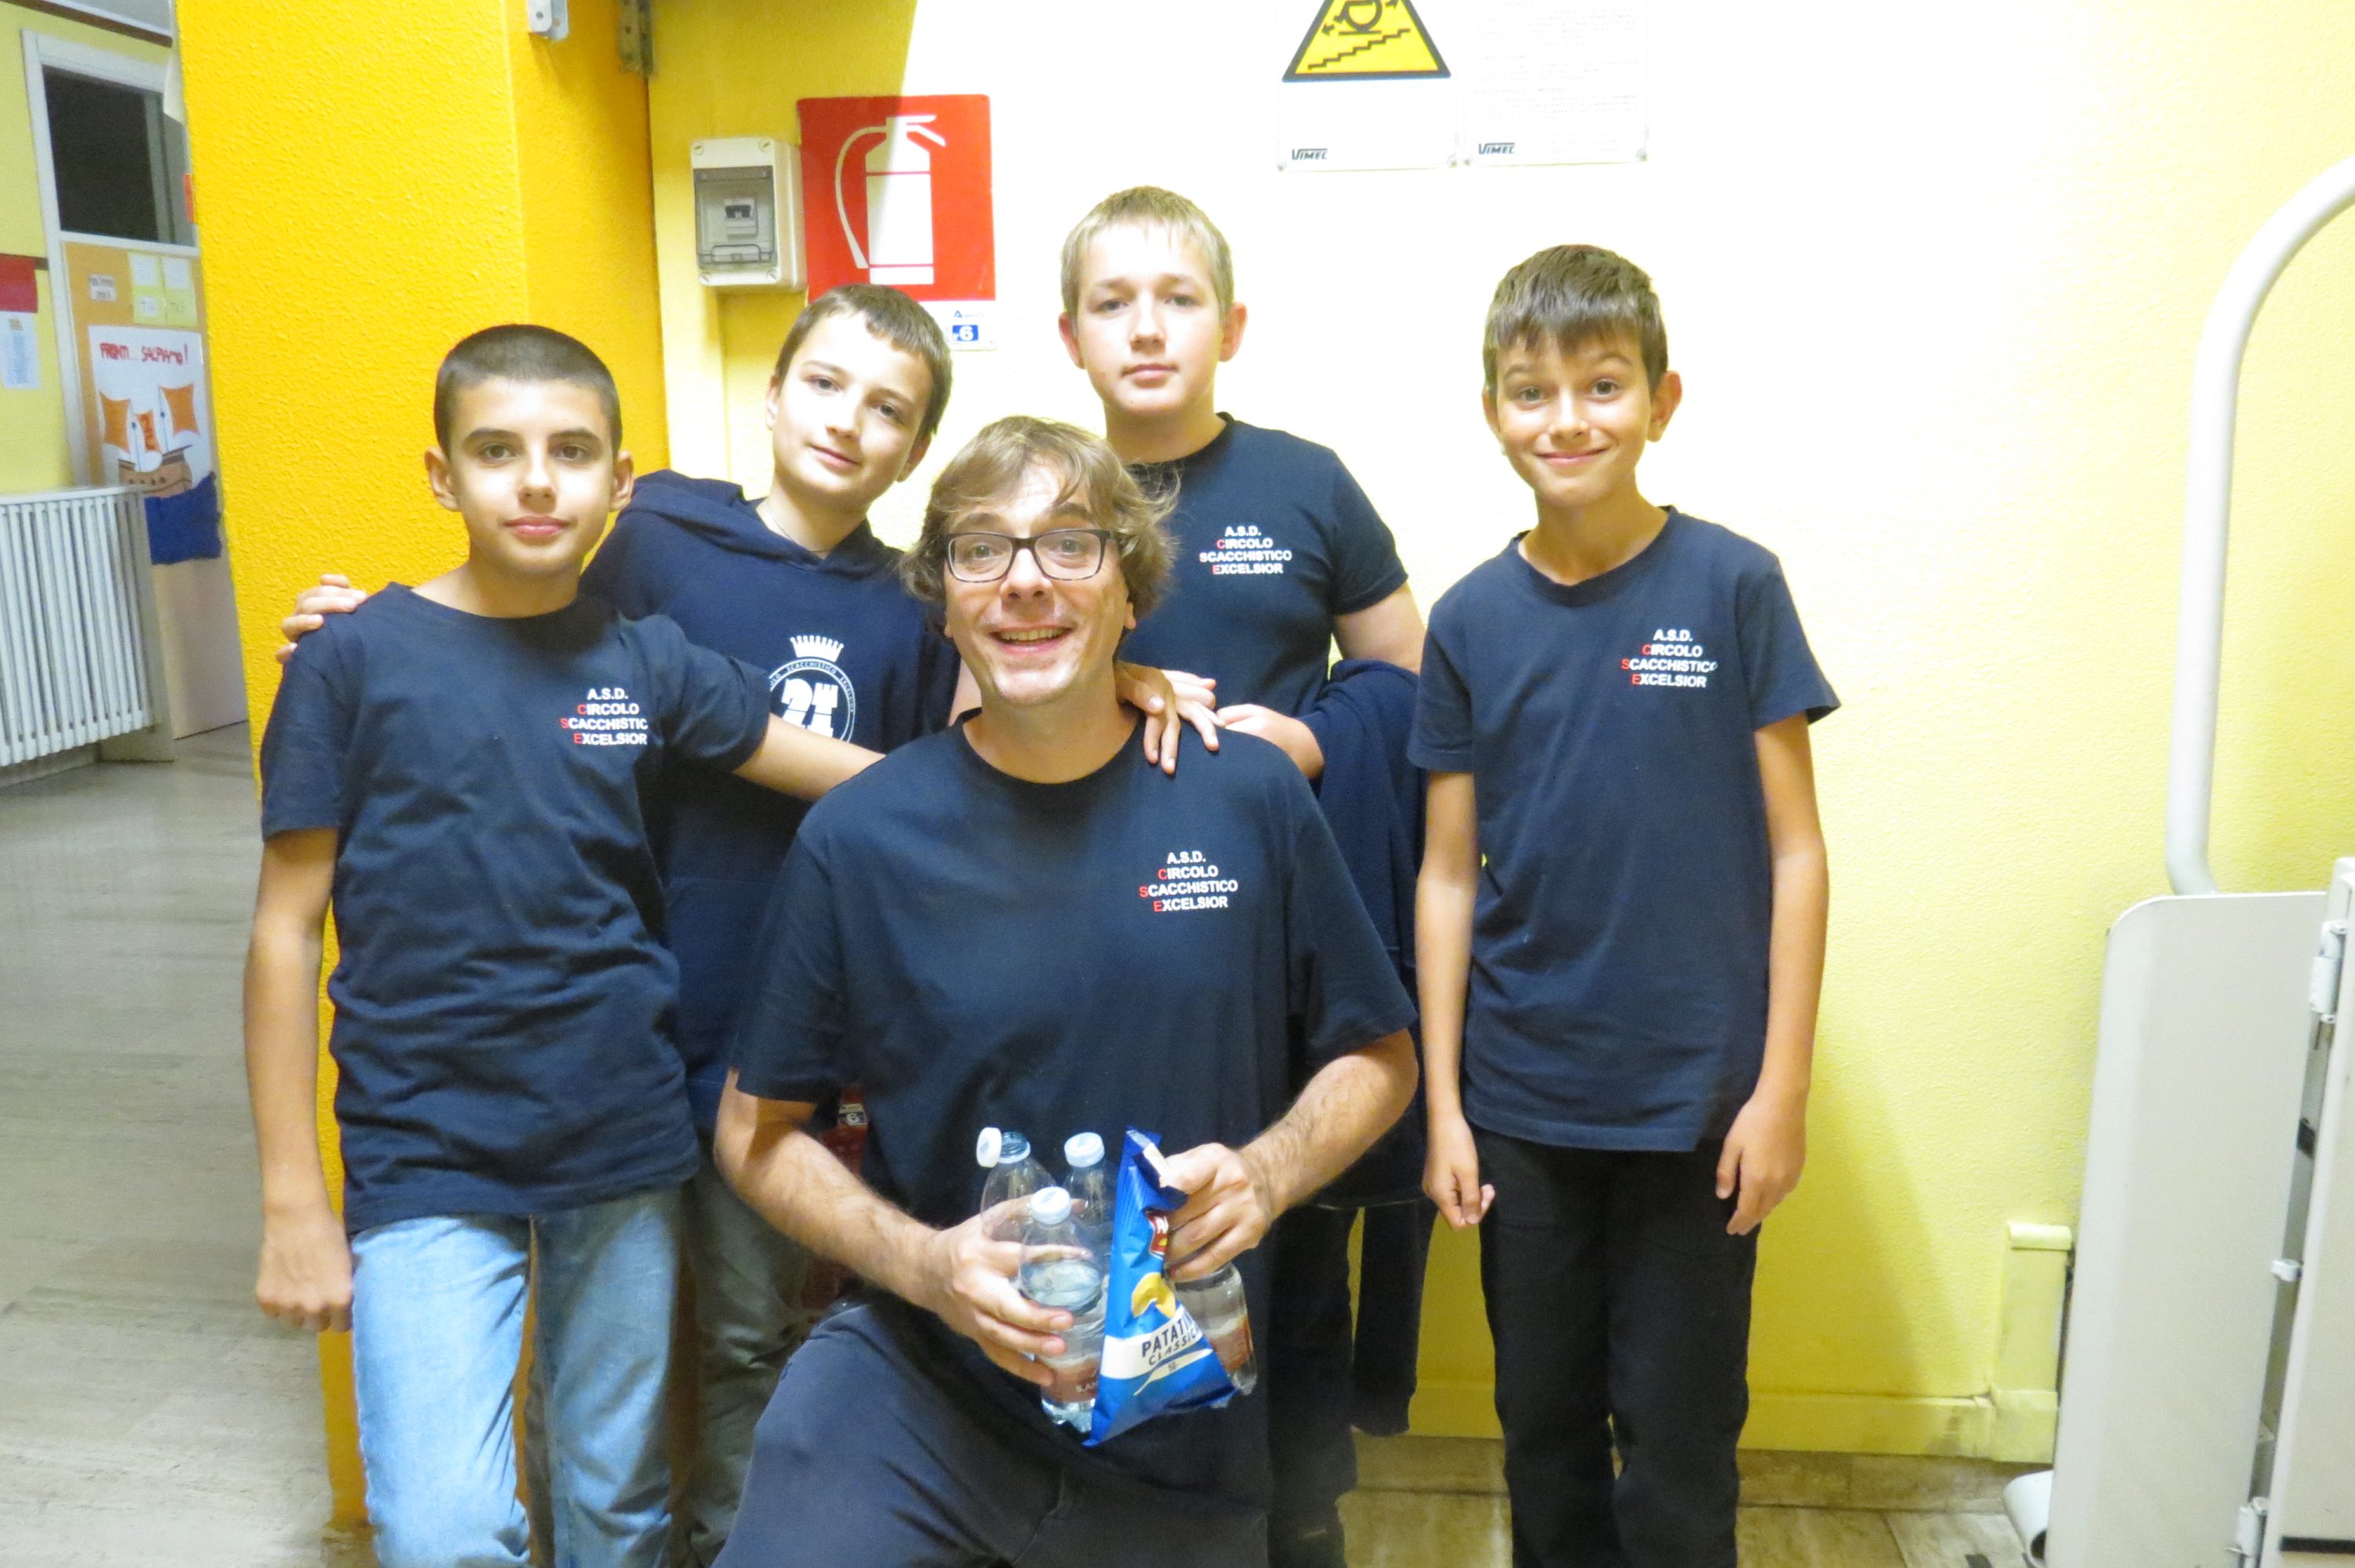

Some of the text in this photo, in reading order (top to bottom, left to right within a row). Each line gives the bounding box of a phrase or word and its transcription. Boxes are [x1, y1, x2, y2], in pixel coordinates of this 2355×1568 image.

[1225, 525, 1261, 537] A.S.D.
[1217, 538, 1273, 549] CIRCOLO
[1199, 550, 1292, 563] SCACCHISTICO
[1212, 563, 1283, 574] EXCELSIOR
[1653, 629, 1693, 642] A.S.D.
[1642, 644, 1703, 658] CIRCOLO
[787, 661, 837, 674] SCACCHISTICO
[1621, 658, 1718, 673] SCACCHISTICO
[1632, 673, 1707, 687] EXCELSIOR
[587, 687, 628, 700] A.S.D.
[577, 703, 640, 715] CIRCOLO
[560, 717, 648, 730] SCACCHISTIC
[574, 733, 648, 745] EXCELSIOR
[1167, 851, 1206, 864] A.S.D.
[1157, 865, 1218, 880] CIRCOLO
[1139, 880, 1238, 897] SCACCHISTICO
[1153, 895, 1229, 912] EXCELSIOR
[1148, 1327, 1197, 1366] CLASSIC
